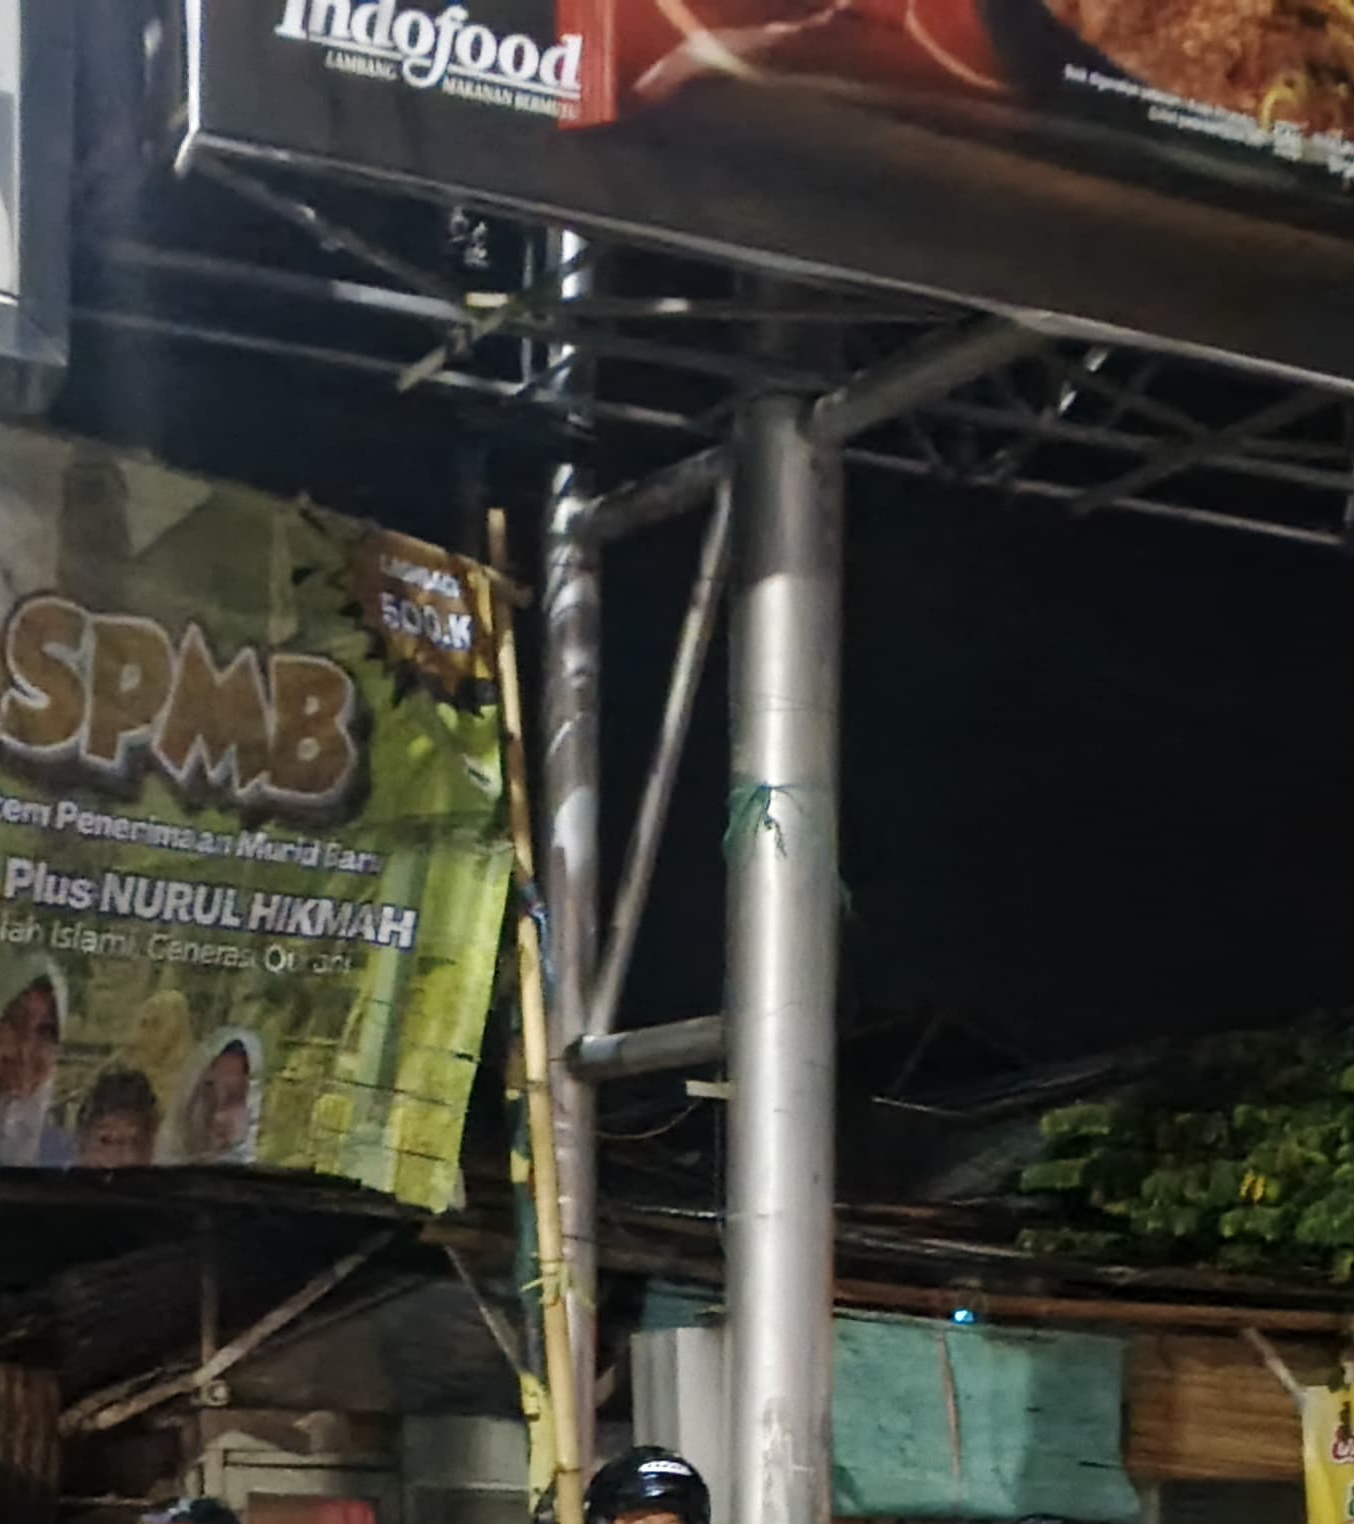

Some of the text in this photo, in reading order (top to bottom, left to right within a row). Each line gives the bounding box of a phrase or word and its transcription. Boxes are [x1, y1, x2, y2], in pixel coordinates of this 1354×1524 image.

[274, 0, 584, 88] Indofood
[3, 856, 96, 910] Plus
[98, 872, 241, 928] NURUL
[246, 891, 419, 949] HIKMAH
